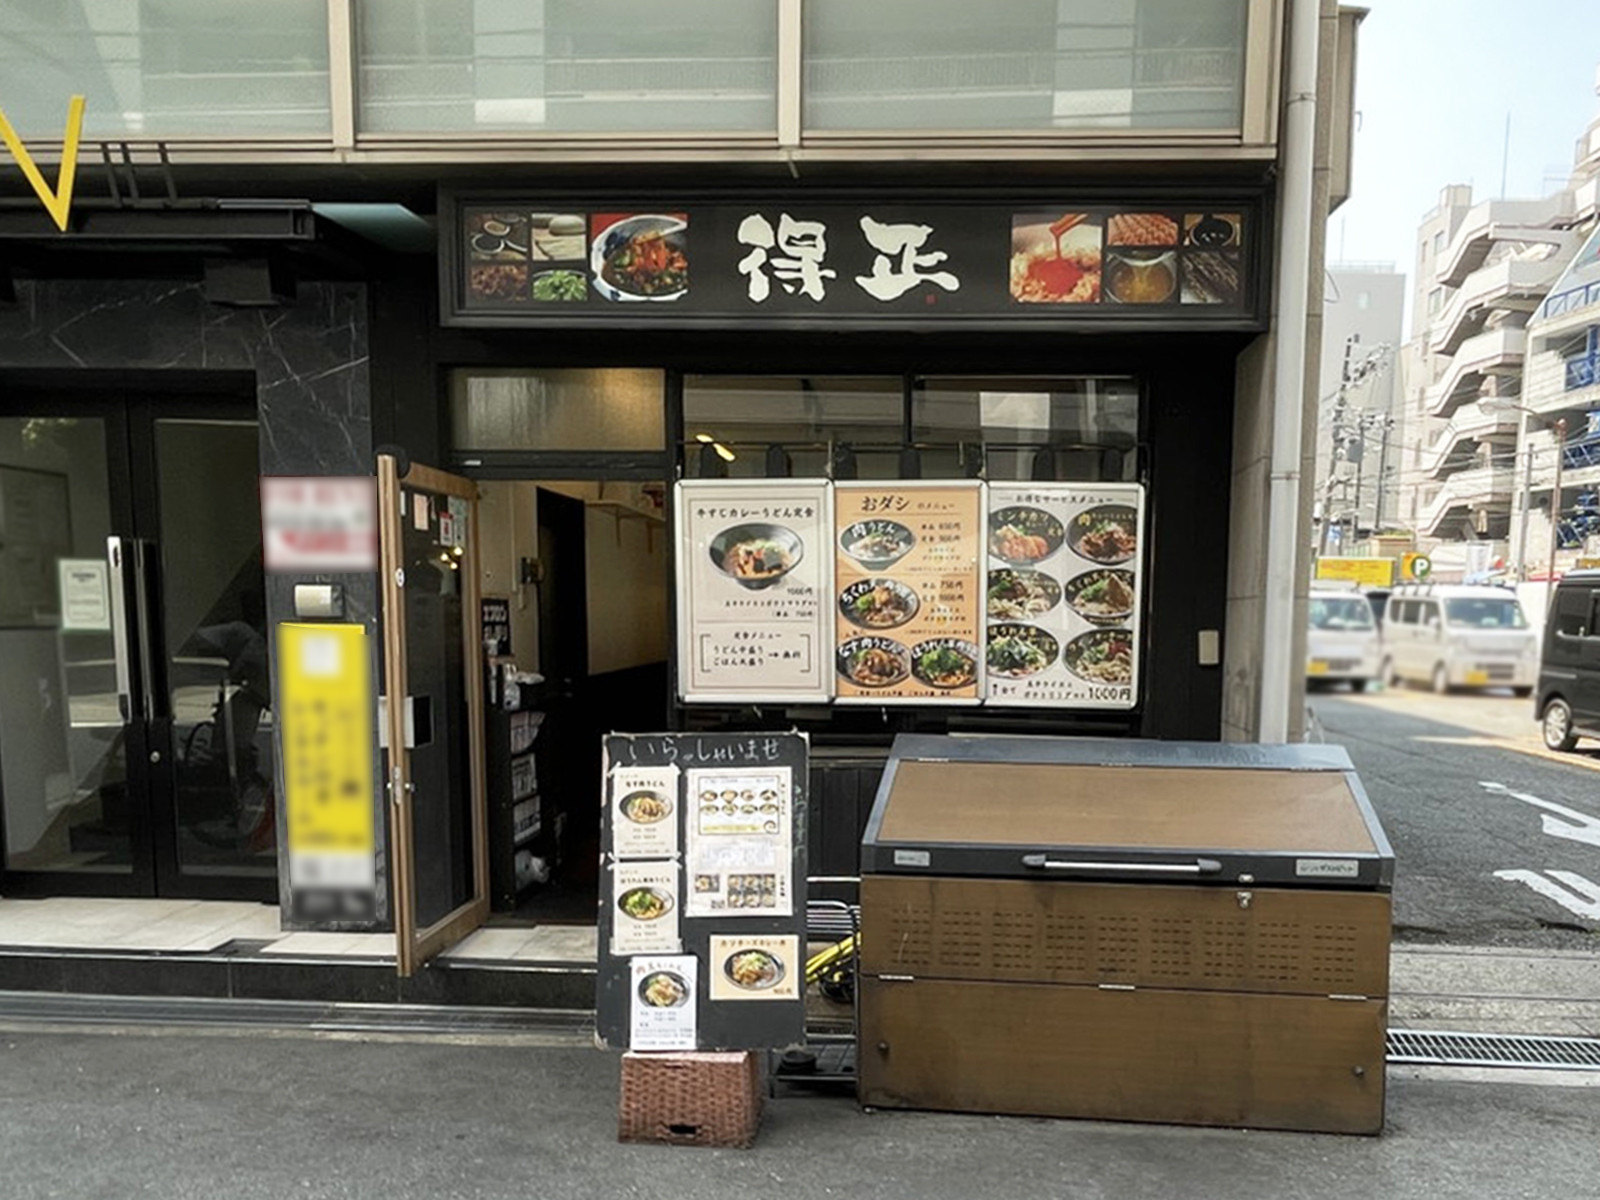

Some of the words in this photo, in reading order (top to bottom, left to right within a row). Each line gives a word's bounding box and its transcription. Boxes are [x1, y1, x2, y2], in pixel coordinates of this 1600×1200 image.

[737, 212, 960, 302] 得正
[861, 495, 910, 512] おダシ
[1414, 558, 1429, 576] P
[1088, 687, 1131, 701] 1000円
